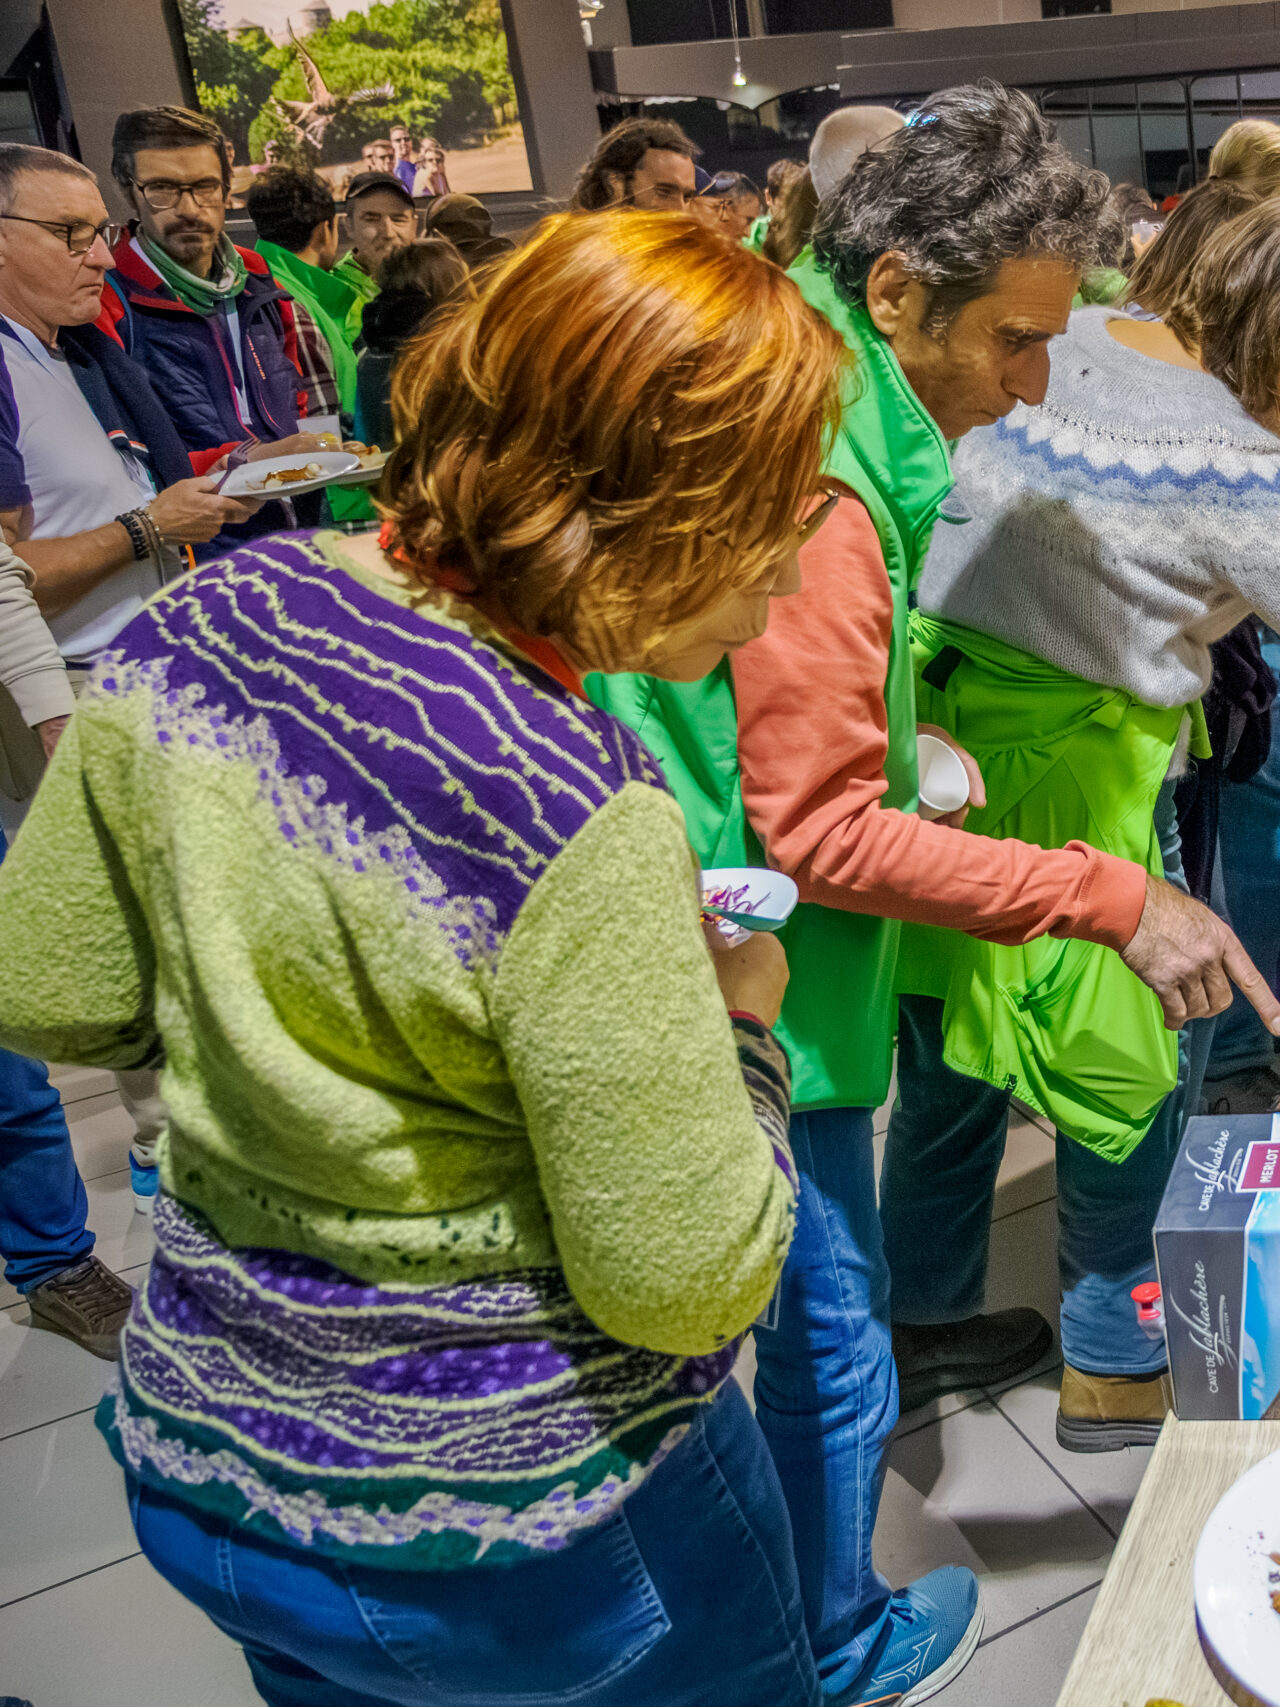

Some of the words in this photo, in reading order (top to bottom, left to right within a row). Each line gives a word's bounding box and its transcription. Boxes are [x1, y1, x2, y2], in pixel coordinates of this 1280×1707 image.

[1260, 1147, 1280, 1184] MERLOT
[1199, 1192, 1211, 1211] CAVE
[1206, 1354, 1216, 1368] DE
[1208, 1367, 1219, 1394] CAVE
